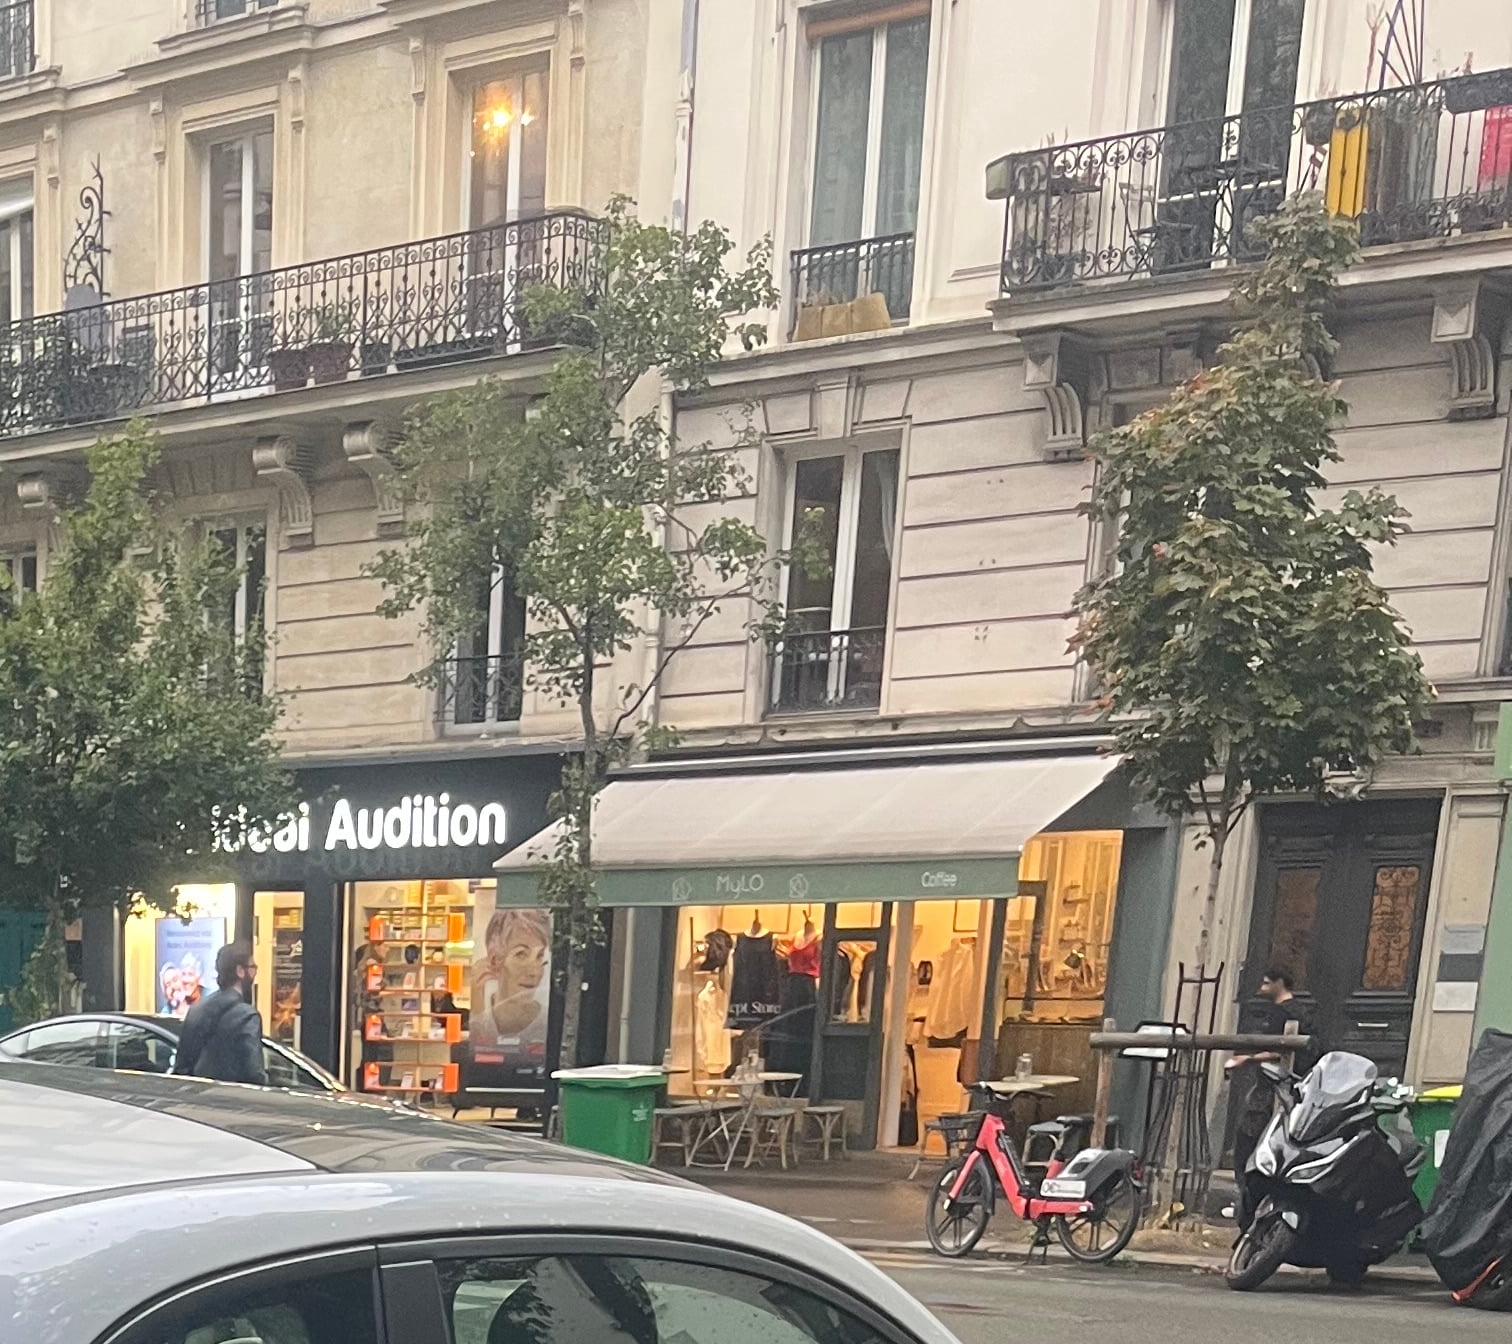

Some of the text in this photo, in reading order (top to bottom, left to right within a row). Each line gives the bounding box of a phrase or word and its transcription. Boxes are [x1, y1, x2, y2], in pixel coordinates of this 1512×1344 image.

[324, 792, 506, 850] Audition
[921, 871, 957, 887] Coffee
[751, 1001, 782, 1014] Store
